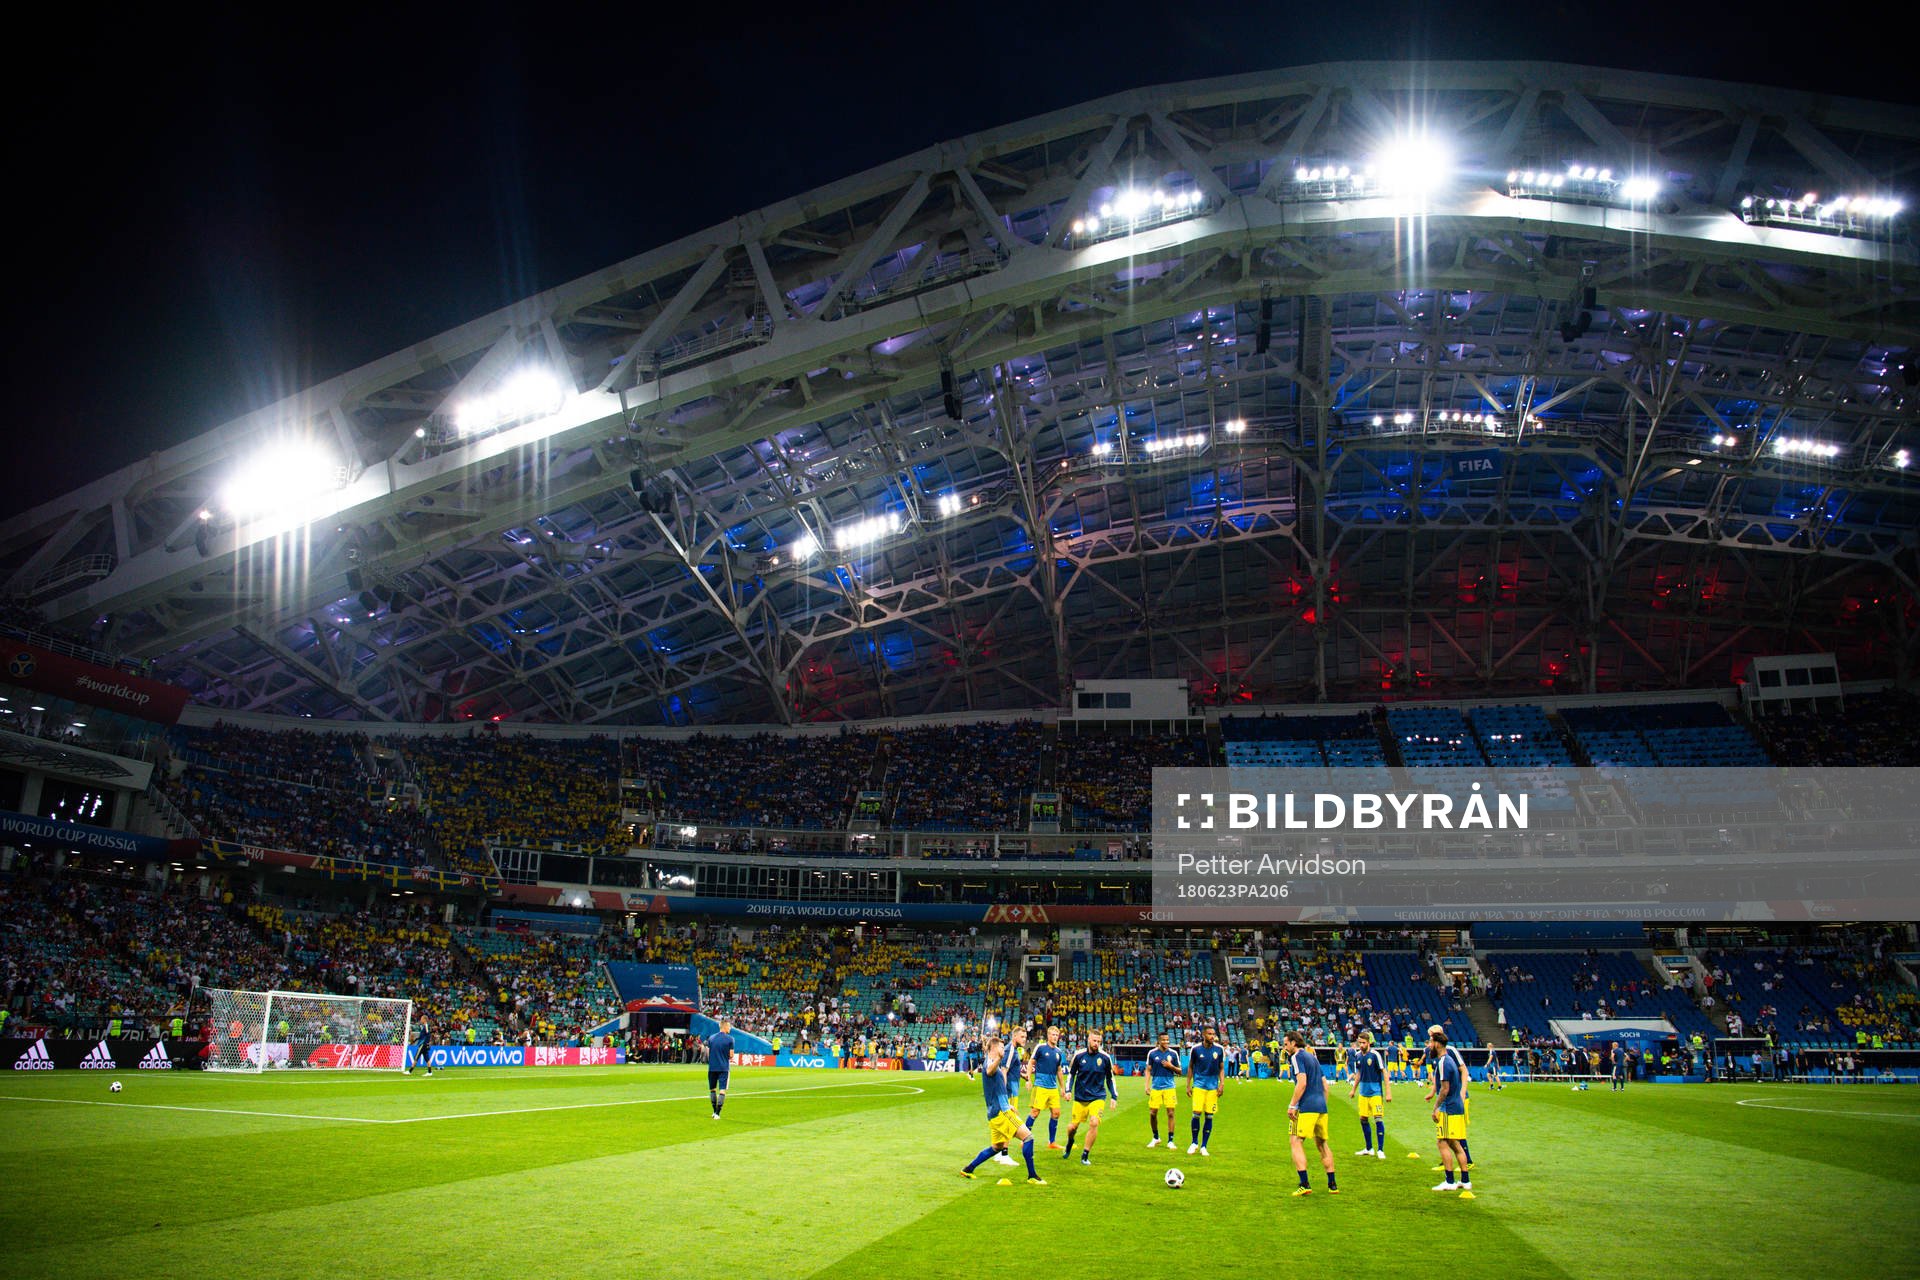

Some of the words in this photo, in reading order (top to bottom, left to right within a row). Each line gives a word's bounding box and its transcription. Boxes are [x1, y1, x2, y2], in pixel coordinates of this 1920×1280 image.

[1458, 458, 1494, 472] FIFA
[76, 674, 151, 706] #worldcup
[2, 817, 54, 838] WORLD
[56, 827, 86, 842] CUP
[88, 833, 137, 851] RUSSIA
[746, 903, 772, 914] 2018
[773, 904, 795, 915] FIFA
[798, 906, 836, 916] WORLD
[838, 906, 861, 917] CUP
[864, 907, 903, 918] RUSSIA
[1138, 911, 1174, 921] SOCHI
[1654, 908, 1706, 918] РОССИИ
[333, 1043, 380, 1068] Bud
[450, 1046, 487, 1065] vivo
[489, 1046, 523, 1065] vivo
[789, 1053, 825, 1068] vivo
[14, 1058, 55, 1071] adidas
[79, 1058, 117, 1070] adidas
[138, 1058, 173, 1070] adidas
[921, 1059, 955, 1072] VISA
